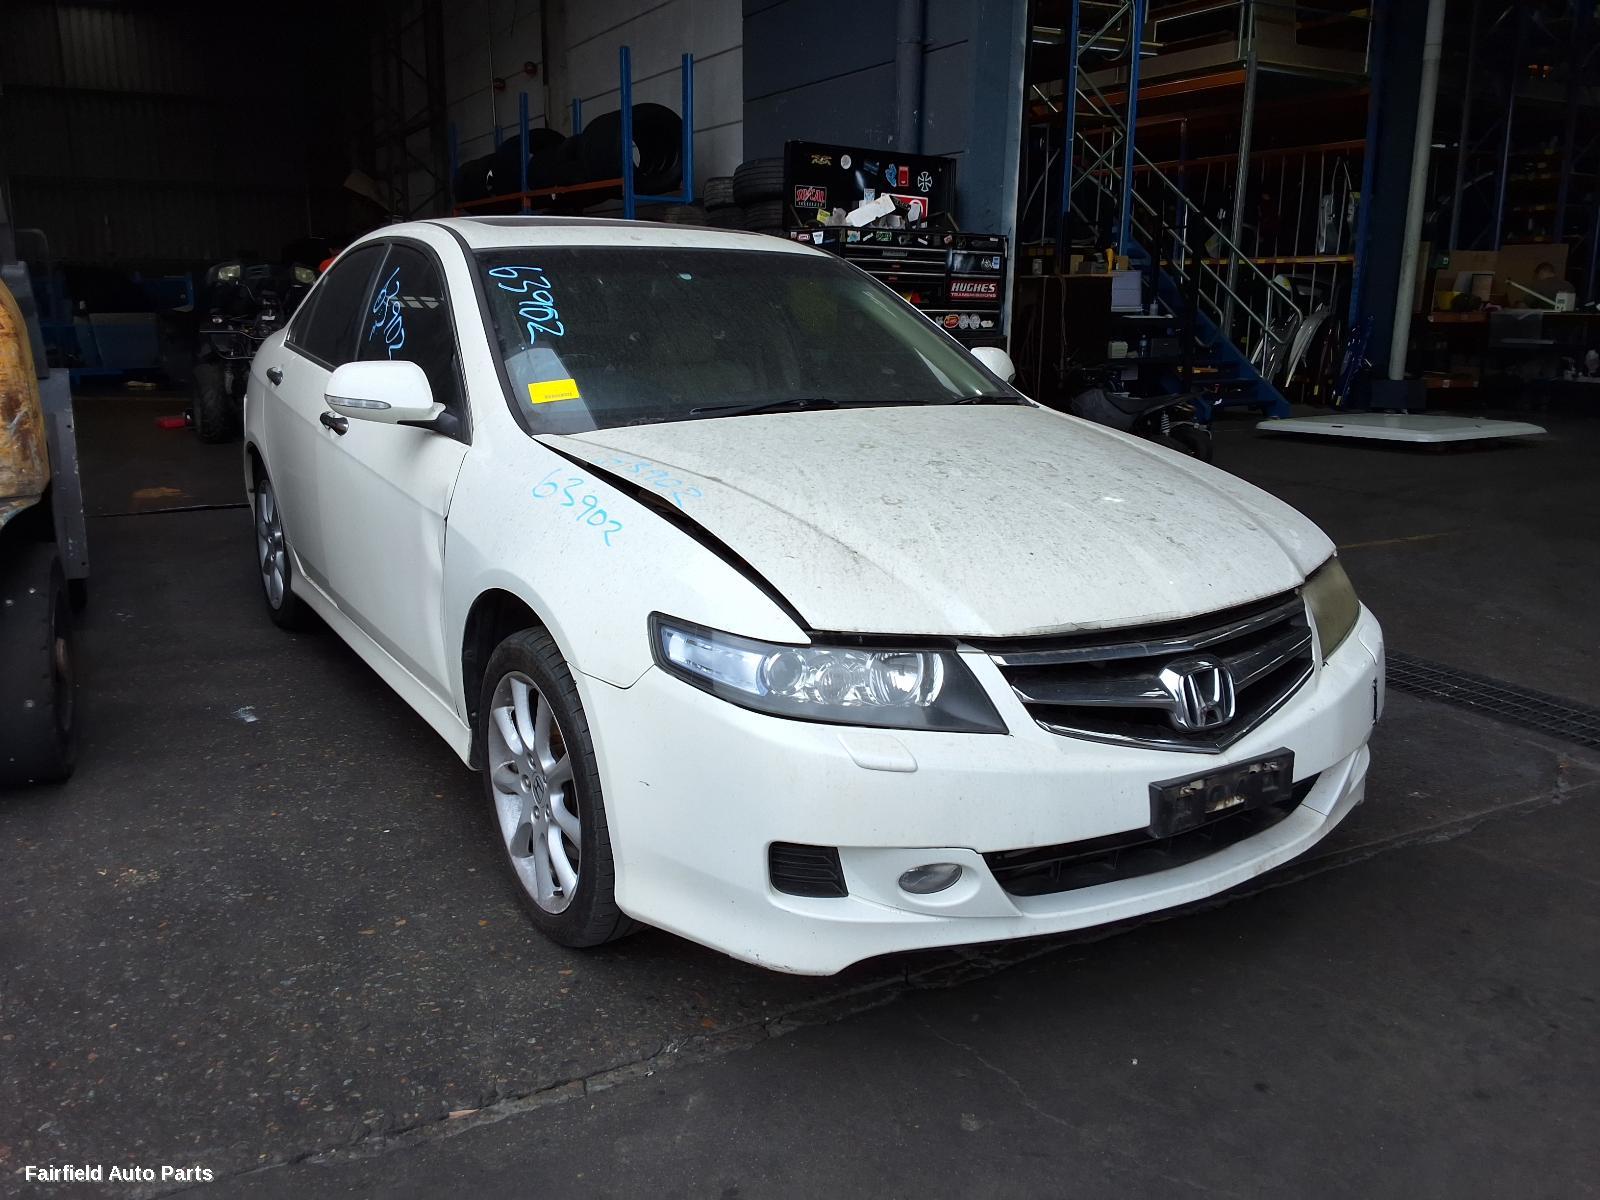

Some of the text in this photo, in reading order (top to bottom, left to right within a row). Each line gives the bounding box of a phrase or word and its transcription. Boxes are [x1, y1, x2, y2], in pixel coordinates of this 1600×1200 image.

[488, 265, 565, 345] 63902
[951, 282, 997, 293] HUGHES
[531, 468, 624, 548] 63902
